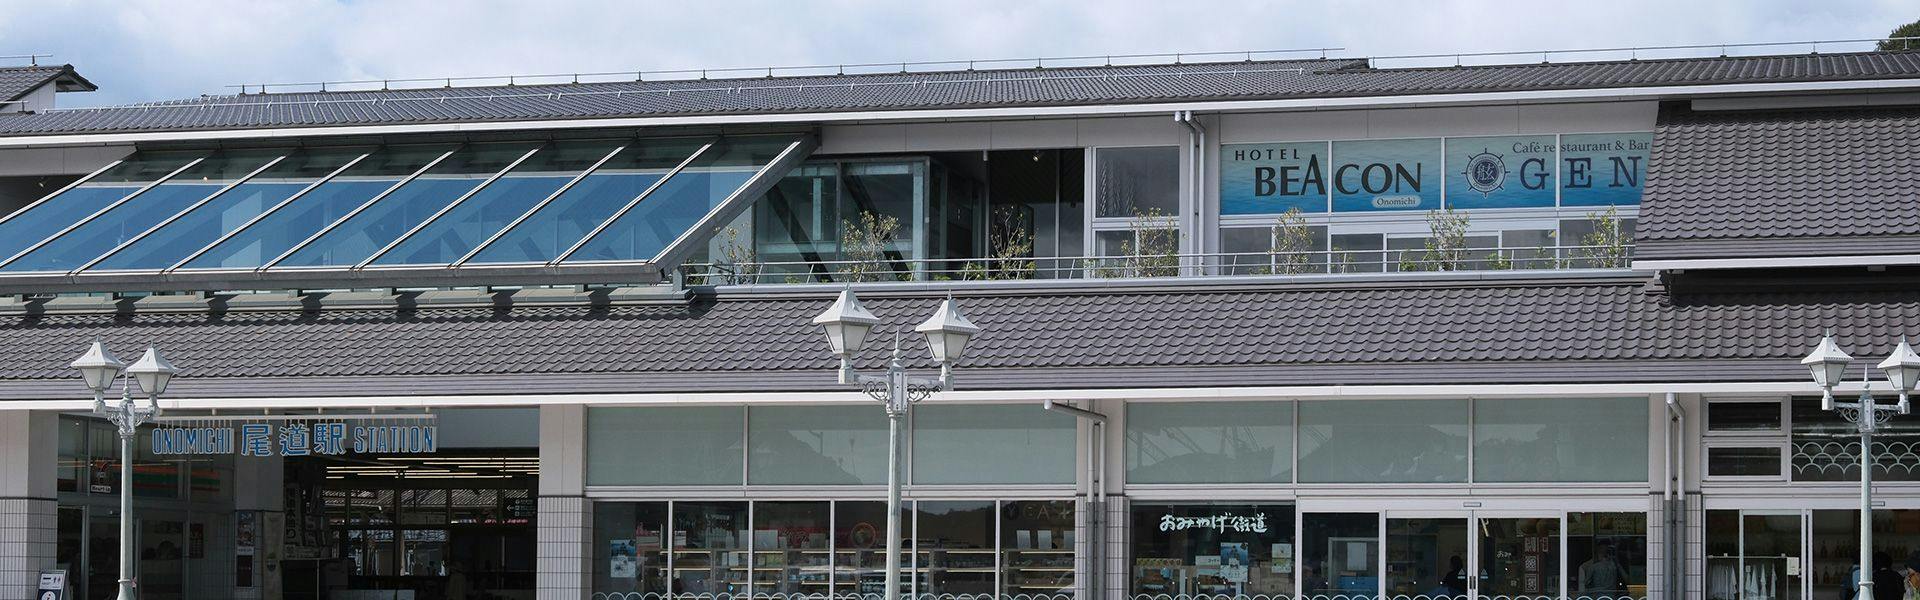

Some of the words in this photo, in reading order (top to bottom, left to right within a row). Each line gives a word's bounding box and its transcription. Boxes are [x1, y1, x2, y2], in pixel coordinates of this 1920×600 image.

[1235, 149, 1300, 161] HOTEL
[1512, 141, 1541, 154] Café
[1544, 142, 1611, 153] restaurant
[1615, 140, 1625, 151] &
[1629, 140, 1650, 150] Bar
[1255, 154, 1421, 197] BEACON
[1520, 156, 1642, 190] GEN
[1376, 197, 1416, 206] Onomichi
[152, 427, 234, 455] ONOMICHI
[241, 422, 346, 456] 尾道駅
[354, 426, 437, 453] STATION
[1160, 512, 1268, 534] おみやげ街道
